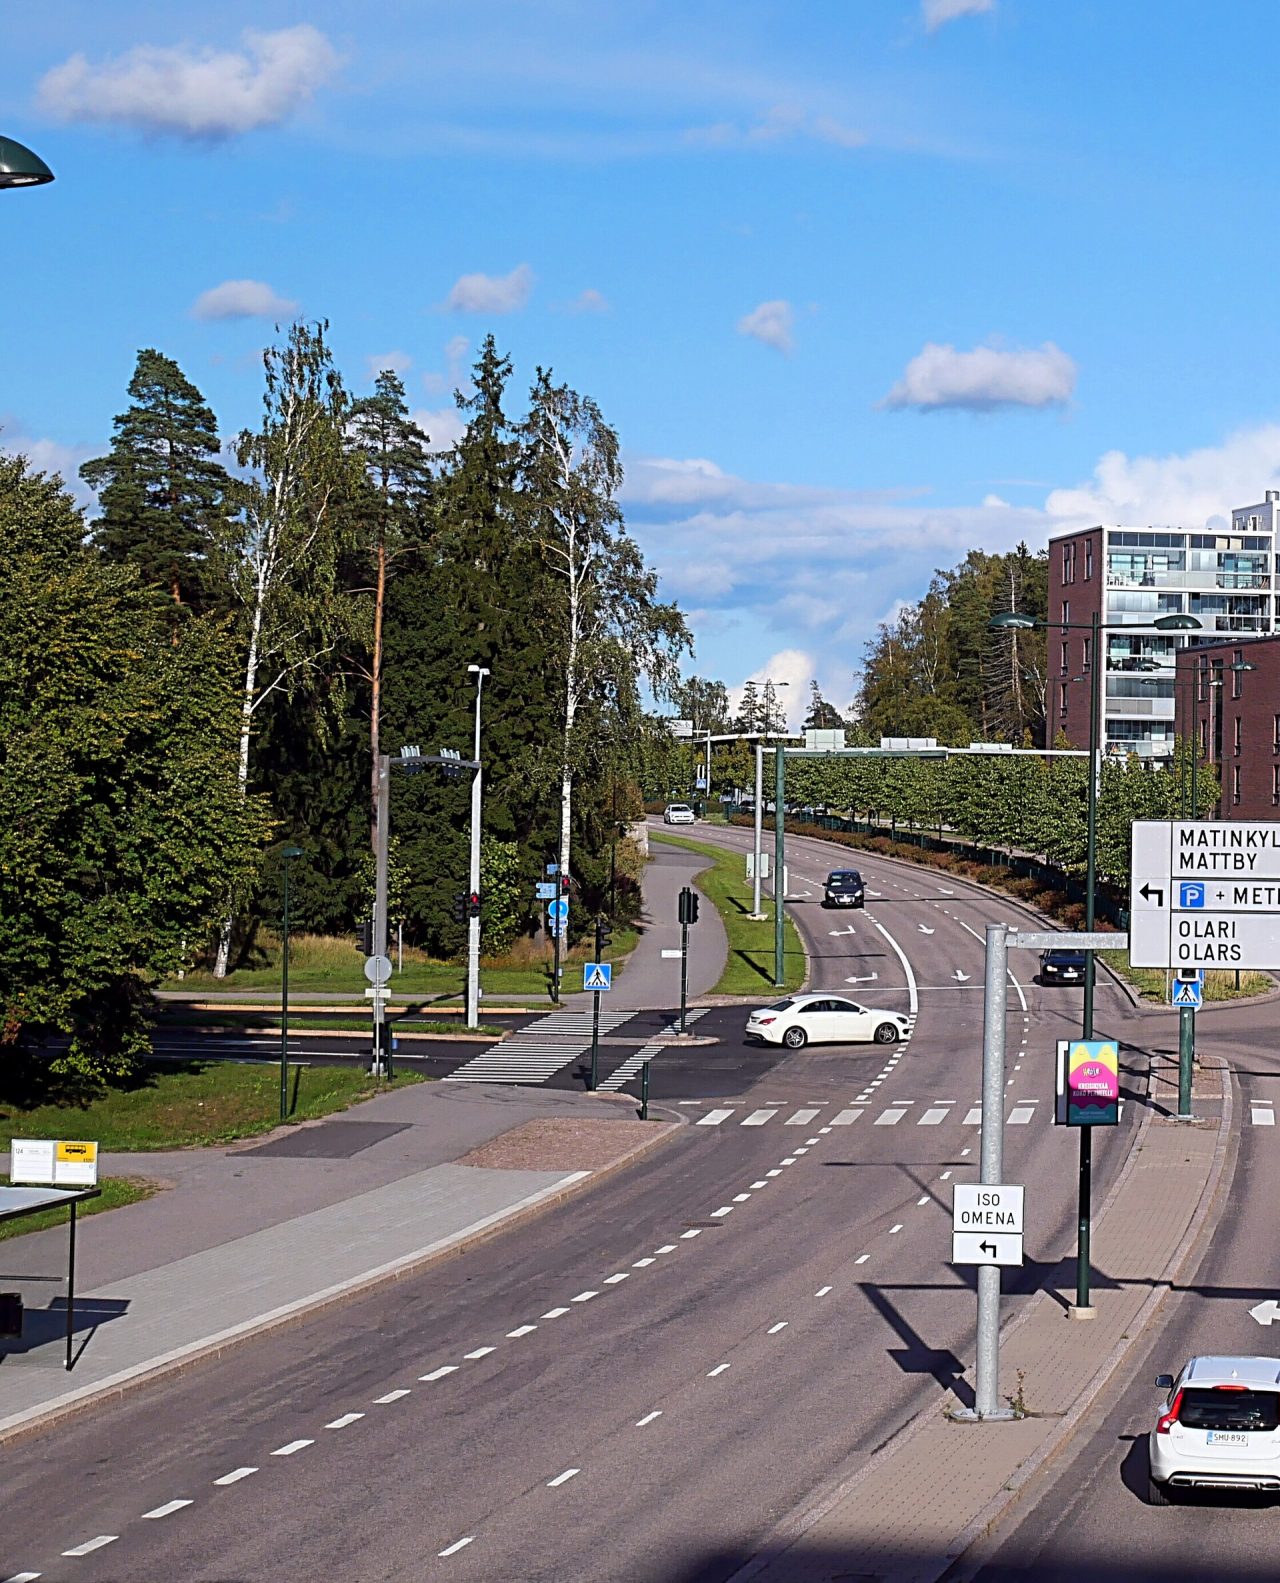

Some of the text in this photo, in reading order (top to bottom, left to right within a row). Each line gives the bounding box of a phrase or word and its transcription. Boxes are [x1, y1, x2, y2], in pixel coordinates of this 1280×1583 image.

[1180, 853, 1256, 870] MATTBY
[1180, 921, 1235, 938] OLARI
[1179, 944, 1240, 960] OLARS
[978, 1194, 999, 1206] ISO
[962, 1212, 1014, 1224] OMENA
